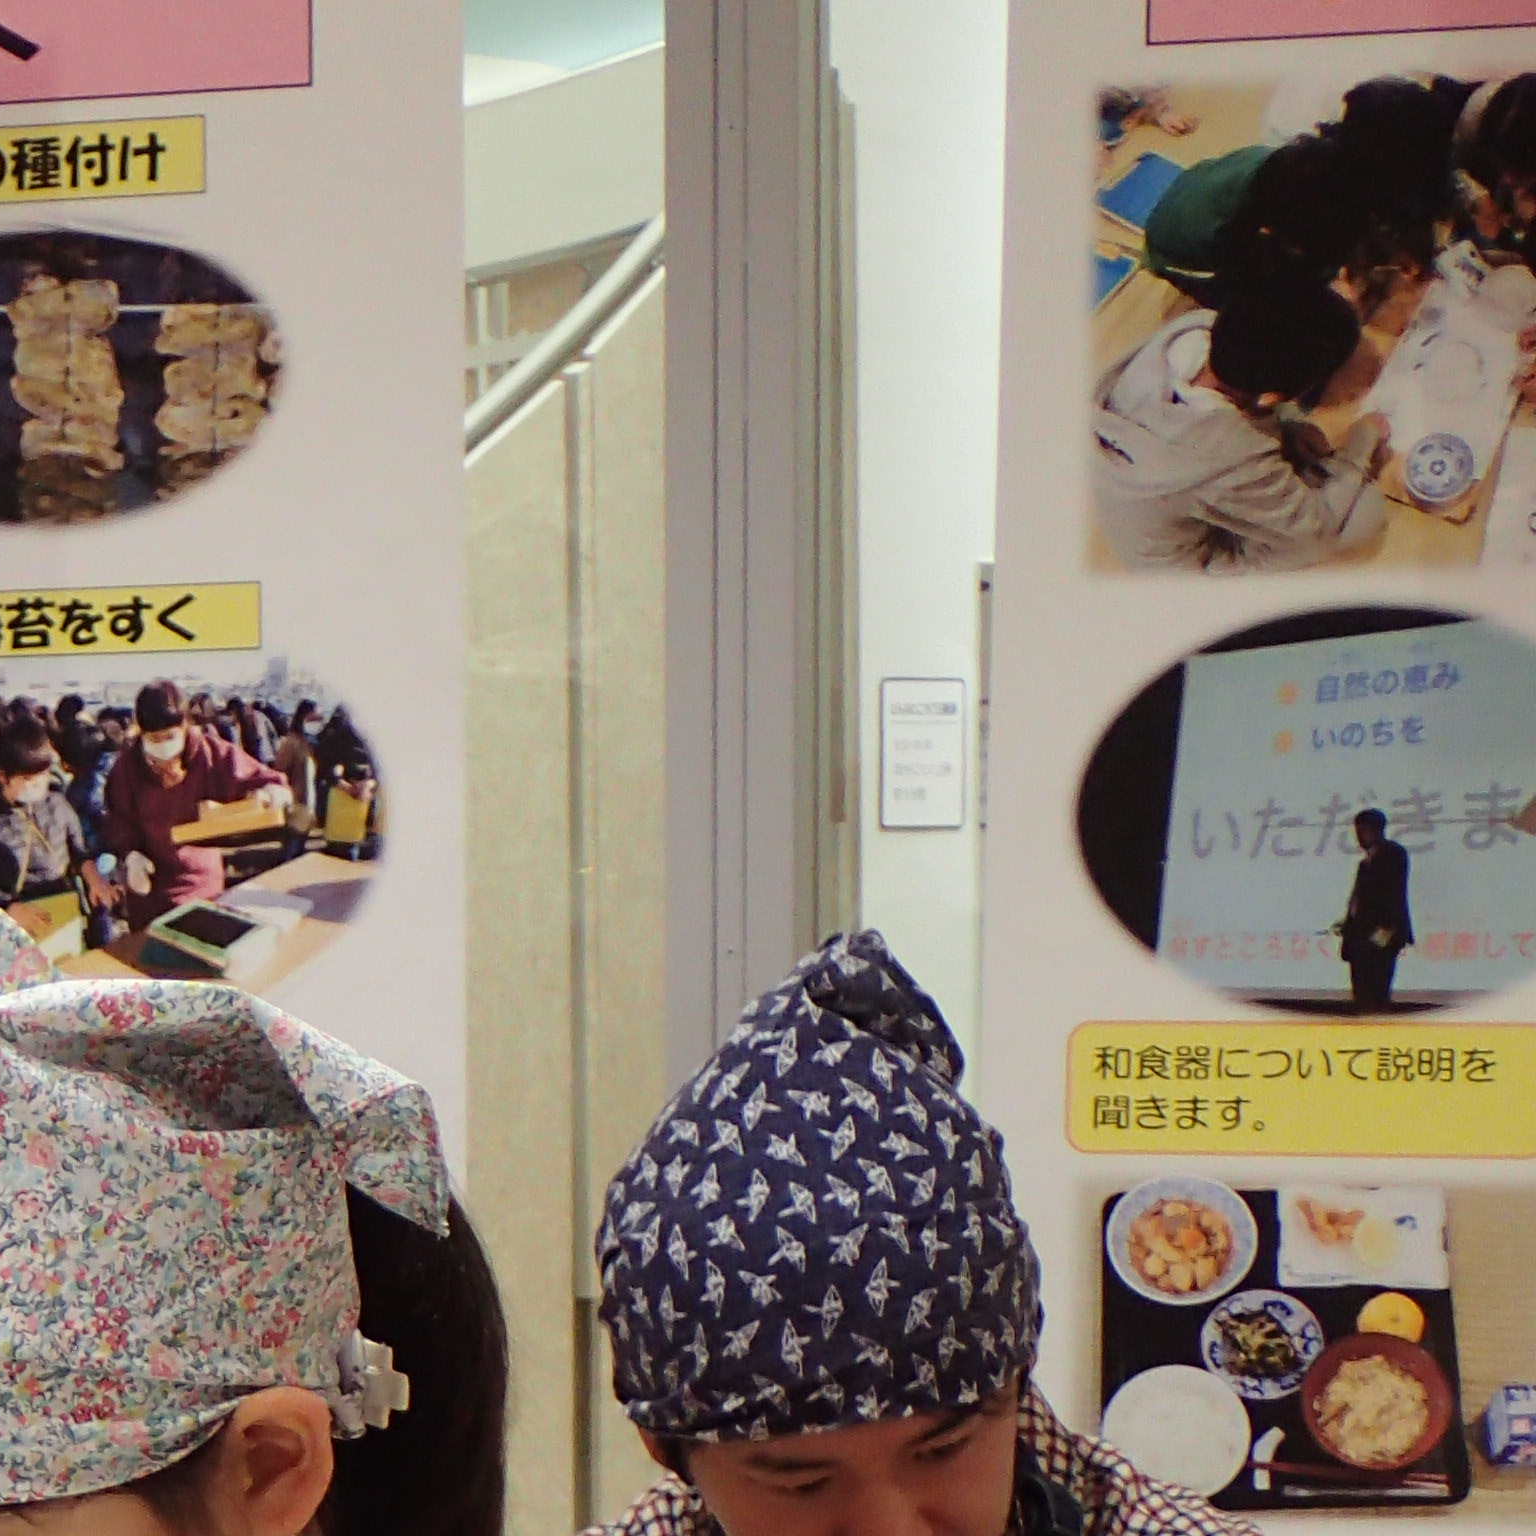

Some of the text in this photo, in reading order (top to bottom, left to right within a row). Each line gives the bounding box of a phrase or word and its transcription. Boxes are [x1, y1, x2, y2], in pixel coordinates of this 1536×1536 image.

[1315, 661, 1461, 704] 自然の恵み
[1311, 715, 1427, 751] いのちを
[1093, 1044, 1497, 1083] 和食器について説明を
[1091, 1095, 1267, 1133] 聞きます。
